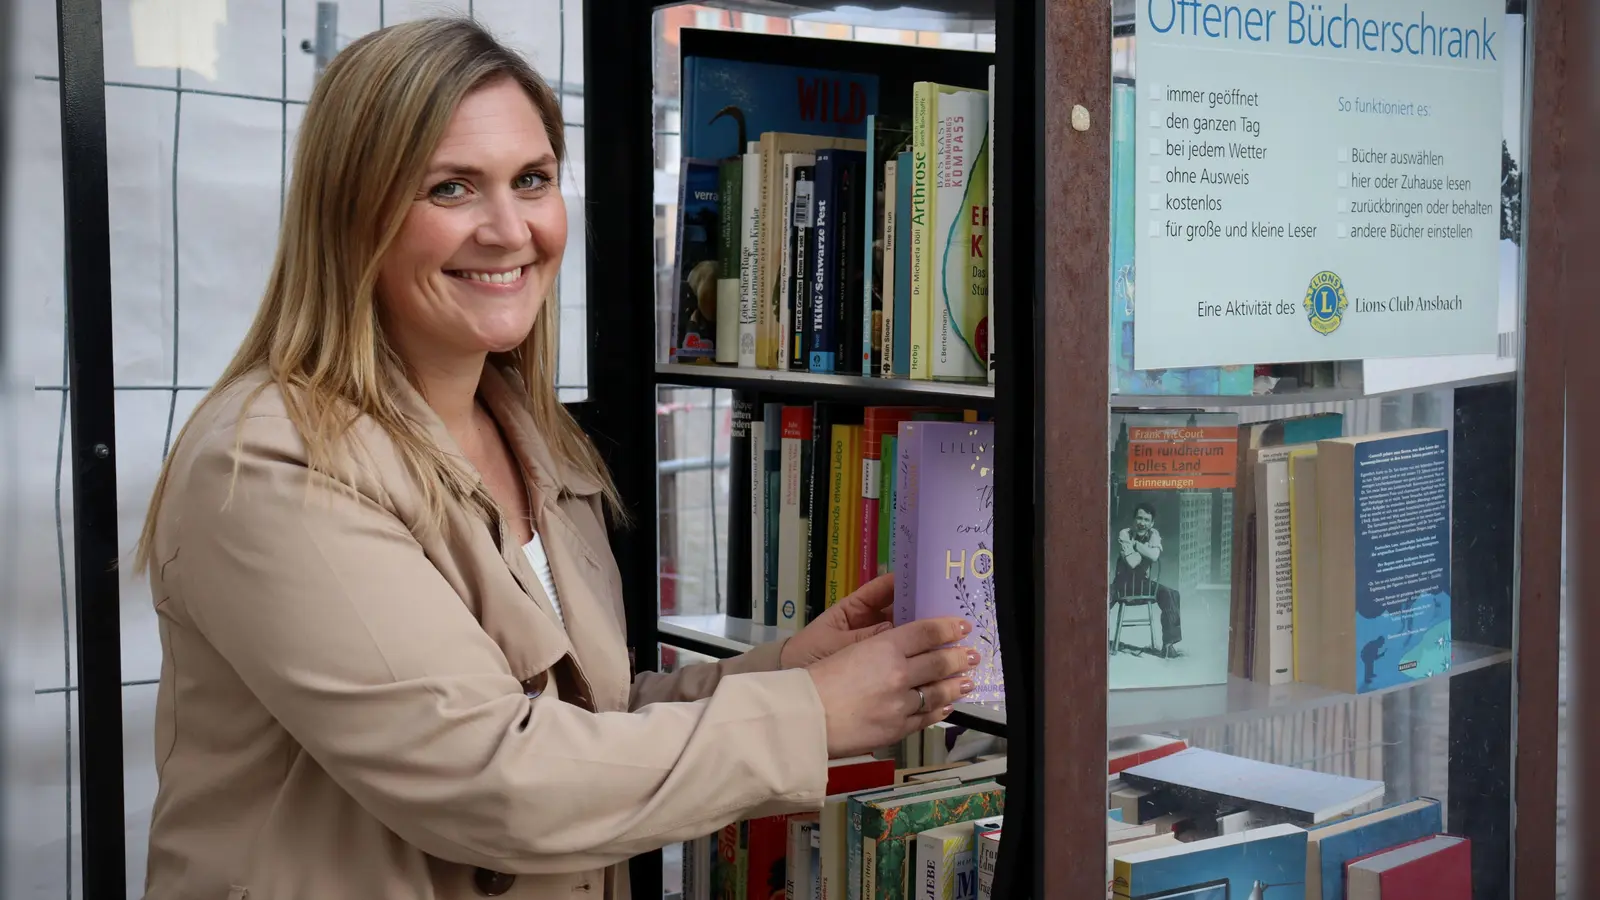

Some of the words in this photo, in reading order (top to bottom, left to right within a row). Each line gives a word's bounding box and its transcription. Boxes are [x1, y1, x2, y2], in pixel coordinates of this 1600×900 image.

[1148, 0, 1277, 42] Offener
[1289, 1, 1497, 61] Bücherschrank
[797, 76, 866, 124] WILD
[1166, 85, 1204, 103] immer
[1208, 88, 1259, 108] geöffnet
[1338, 97, 1351, 112] So
[1354, 97, 1414, 116] funktioniert
[1417, 104, 1431, 117] es:
[1166, 112, 1189, 129] den
[1193, 117, 1236, 134] ganzen
[1240, 116, 1260, 137] Tag
[936, 120, 944, 156] KAST
[944, 116, 953, 170] ERNÄHRUNGS
[952, 116, 964, 187] KOMPASS
[1166, 139, 1184, 157] bei
[1187, 140, 1226, 161] jedem
[1229, 143, 1268, 160] Wetter
[1352, 147, 1387, 164] Bücher
[1390, 150, 1444, 166] auswählen
[936, 162, 944, 188] BAS
[1165, 166, 1196, 184] ohne
[1200, 168, 1250, 185] Ausweis
[1351, 171, 1370, 188] hier
[1374, 172, 1398, 189] oder
[1401, 174, 1443, 190] Zuhause
[1446, 175, 1471, 191] lesen
[912, 151, 926, 226] Arthrose
[816, 200, 827, 226] Pest
[1165, 193, 1222, 211] kostenlos
[1350, 197, 1423, 218] zurückbringen
[1426, 198, 1449, 214] oder
[1452, 199, 1493, 215] behalten
[750, 207, 760, 238] Kinder
[1165, 220, 1182, 237] für
[1186, 220, 1221, 242] große
[1225, 221, 1248, 238] und
[1251, 221, 1284, 238] kleine
[1288, 222, 1317, 238] Leser
[1350, 222, 1386, 238] andere
[1390, 222, 1424, 239] Bücher
[1427, 223, 1473, 239] einstellen
[913, 229, 921, 245] Döll
[971, 234, 984, 257] K
[740, 246, 751, 302] Fisher-Ruge
[748, 240, 759, 296] armenischen
[913, 247, 921, 282] Michaela
[972, 265, 986, 278] Das
[813, 229, 826, 332] TKKG/Schwarze
[912, 284, 920, 296] Dr.
[1312, 273, 1339, 288] LIONS
[796, 282, 804, 308] Graichen
[1321, 291, 1332, 313] L
[1355, 297, 1386, 313] Lions
[1388, 296, 1414, 312] Club
[1415, 294, 1462, 311] Ansbach
[739, 304, 750, 325] Lois
[1198, 301, 1221, 317] Eine
[1225, 300, 1272, 316] Aktivität
[1275, 299, 1295, 315] des
[940, 308, 948, 364] C.Bertelsmann
[911, 344, 920, 370] Herbig
[1134, 429, 1161, 439] Frank
[832, 440, 844, 470] Liebe
[940, 441, 989, 454] LILLY
[1134, 445, 1152, 457] Ein
[1157, 445, 1224, 457] rundherum
[1133, 459, 1167, 472] tolles
[1172, 459, 1201, 472] Land
[832, 472, 842, 503] etwas
[1133, 478, 1194, 490] Erinnerungen
[830, 506, 841, 545] abends
[902, 552, 910, 598] LUCAS
[945, 548, 994, 579] HO
